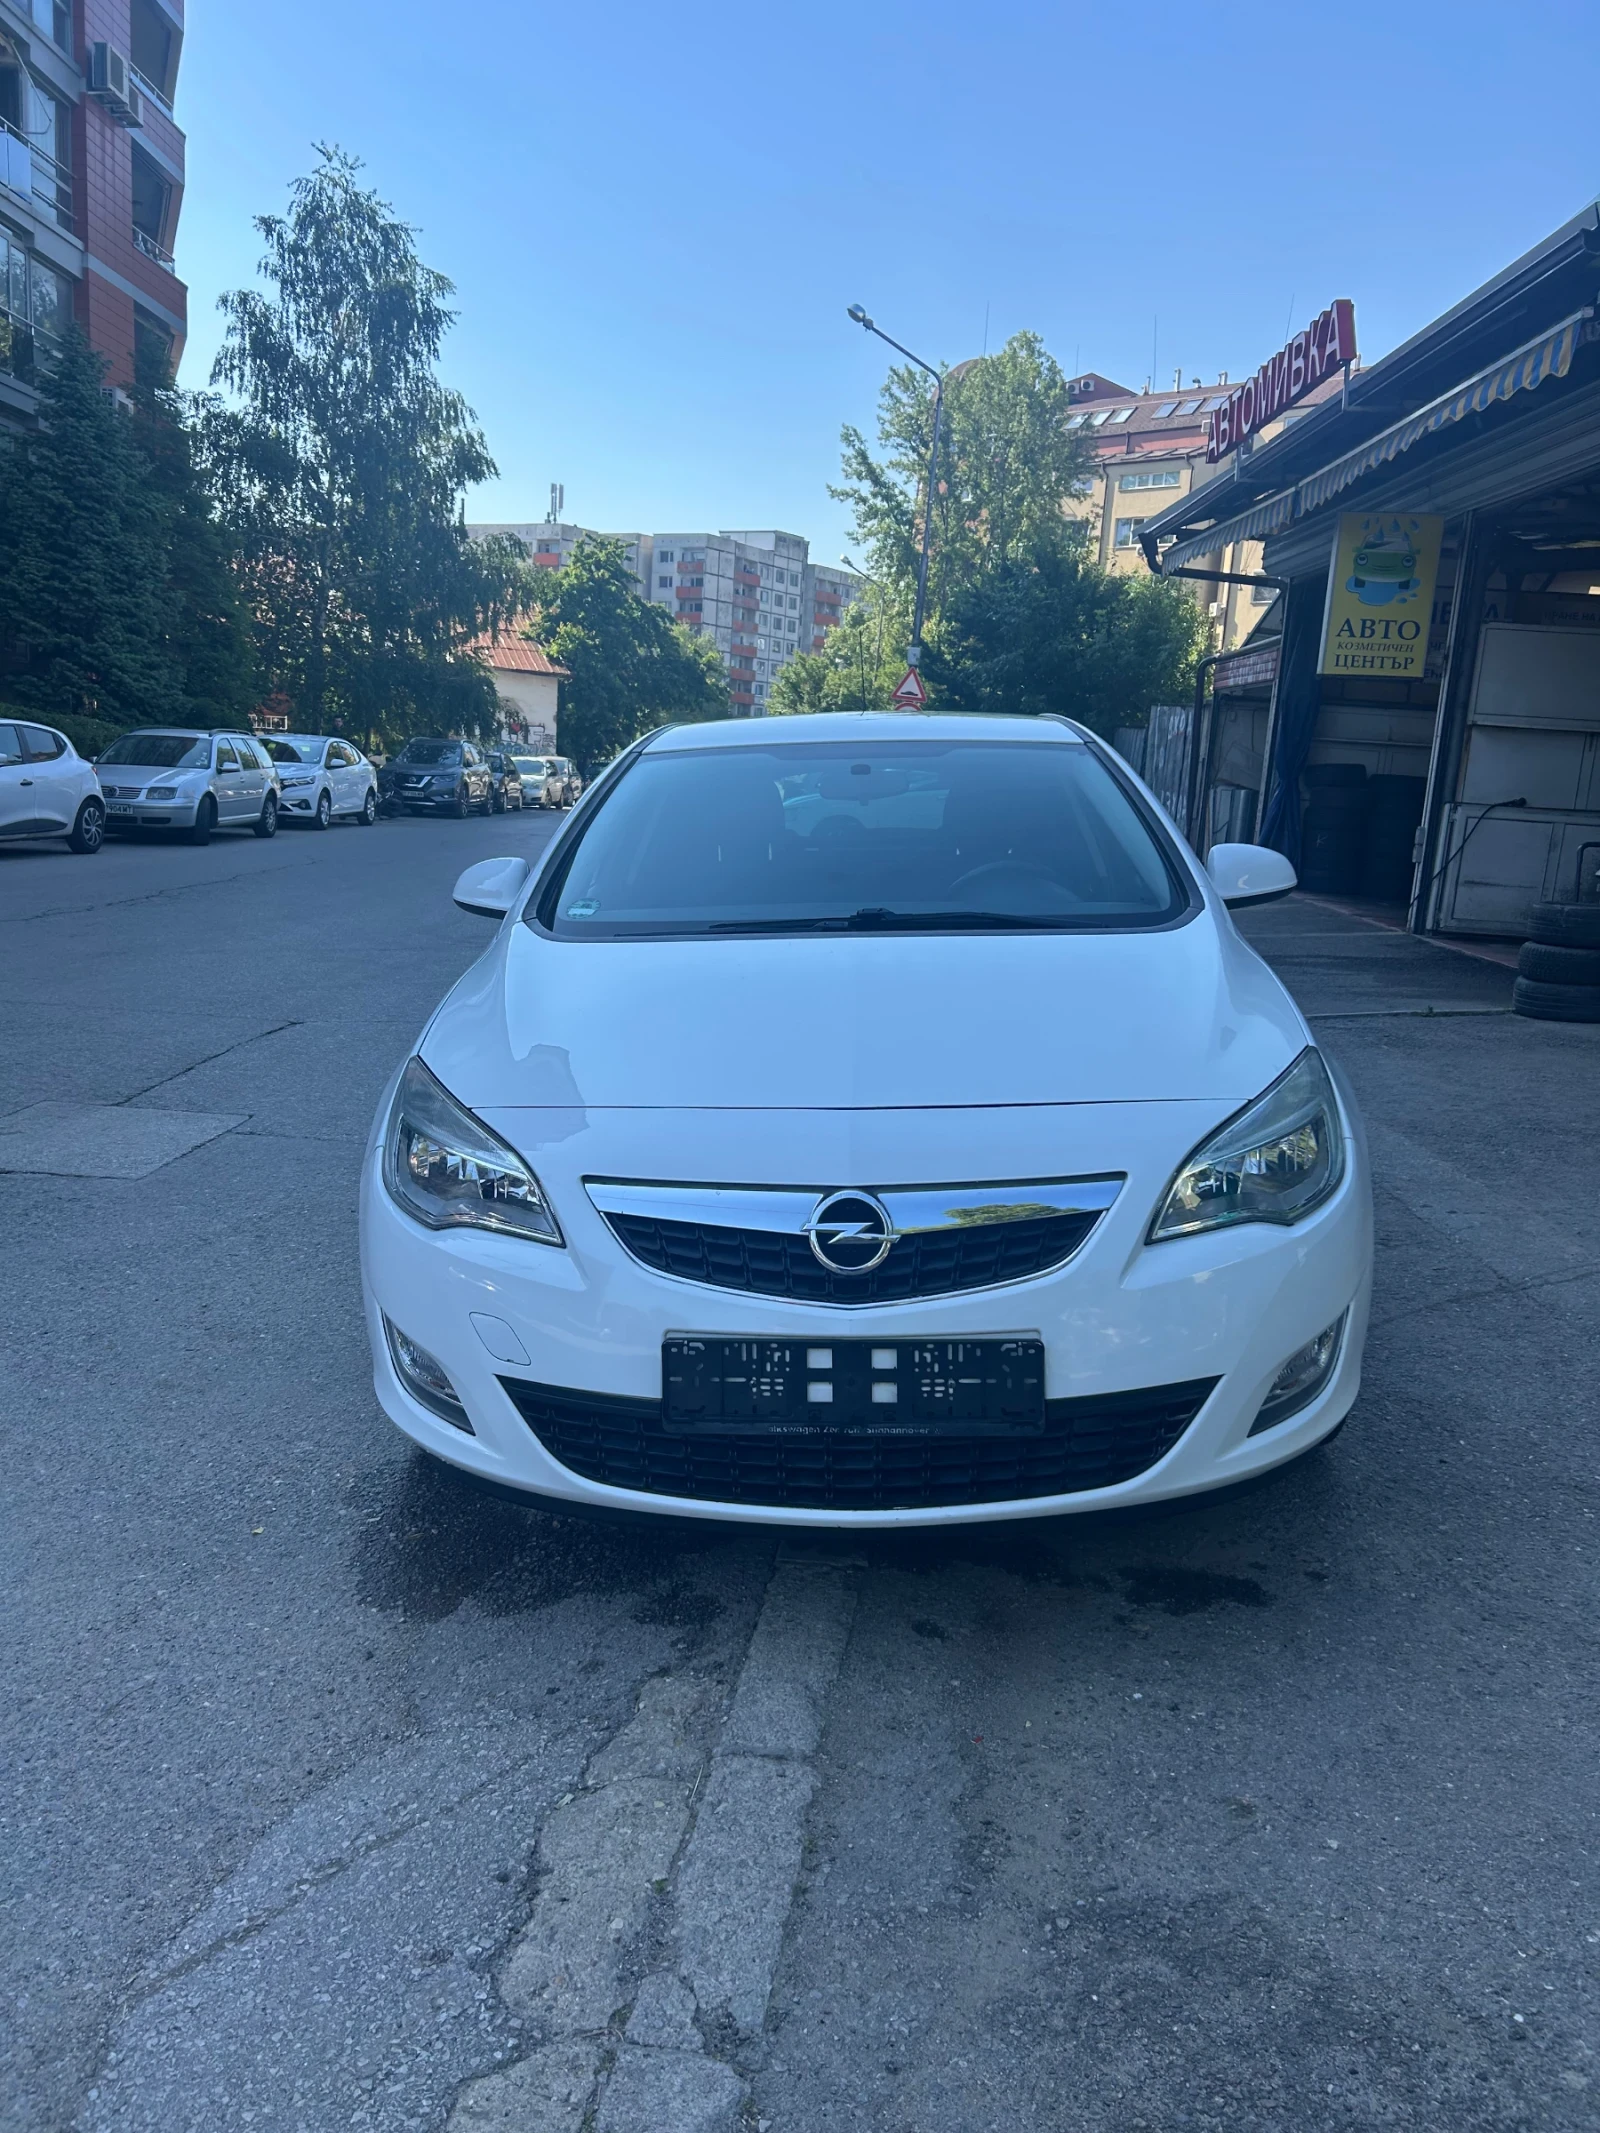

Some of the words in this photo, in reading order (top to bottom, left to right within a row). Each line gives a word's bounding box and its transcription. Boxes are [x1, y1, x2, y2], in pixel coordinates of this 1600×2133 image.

[1206, 299, 1350, 462] АВТОМИВКА
[1335, 618, 1421, 641] АВТО
[1336, 641, 1415, 653] КОЗМЕТИЧЕН
[1333, 653, 1415, 671] ЦЕНТЪР
